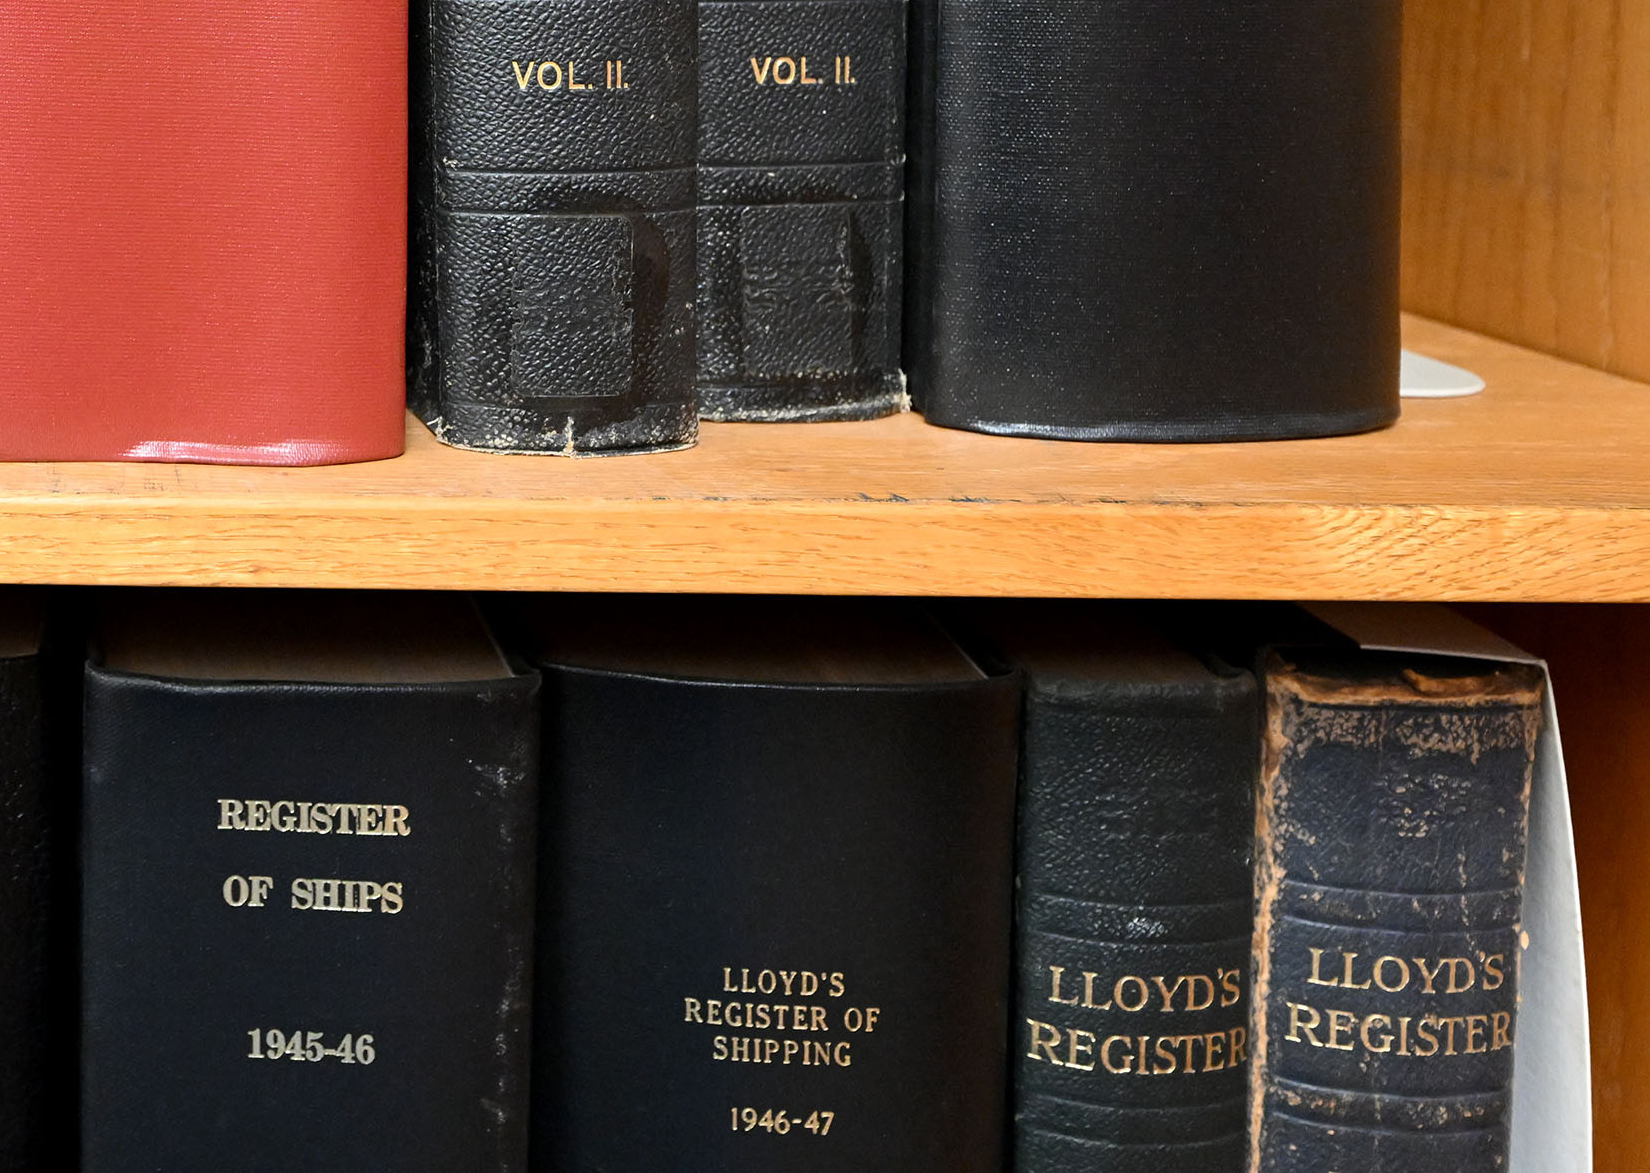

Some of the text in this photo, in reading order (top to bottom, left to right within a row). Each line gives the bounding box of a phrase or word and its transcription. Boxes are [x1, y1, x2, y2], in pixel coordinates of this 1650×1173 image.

[512, 60, 629, 90] VOL. II.
[749, 55, 856, 86] VOL. II.
[216, 798, 411, 838] REGISTER
[222, 875, 404, 915] OF SHIPS
[722, 967, 846, 999] LLOYD'S
[1047, 964, 1242, 1014] LLOYD'S
[1307, 946, 1506, 996] LLOYD'S
[683, 996, 880, 1034] REGISTER OF
[1285, 1003, 1513, 1058] REGISTER
[245, 1027, 376, 1067] 1945-46
[711, 1036, 854, 1069] SHIPPING
[1025, 1018, 1248, 1077] REGISTER
[729, 1106, 835, 1137] 1946-47
